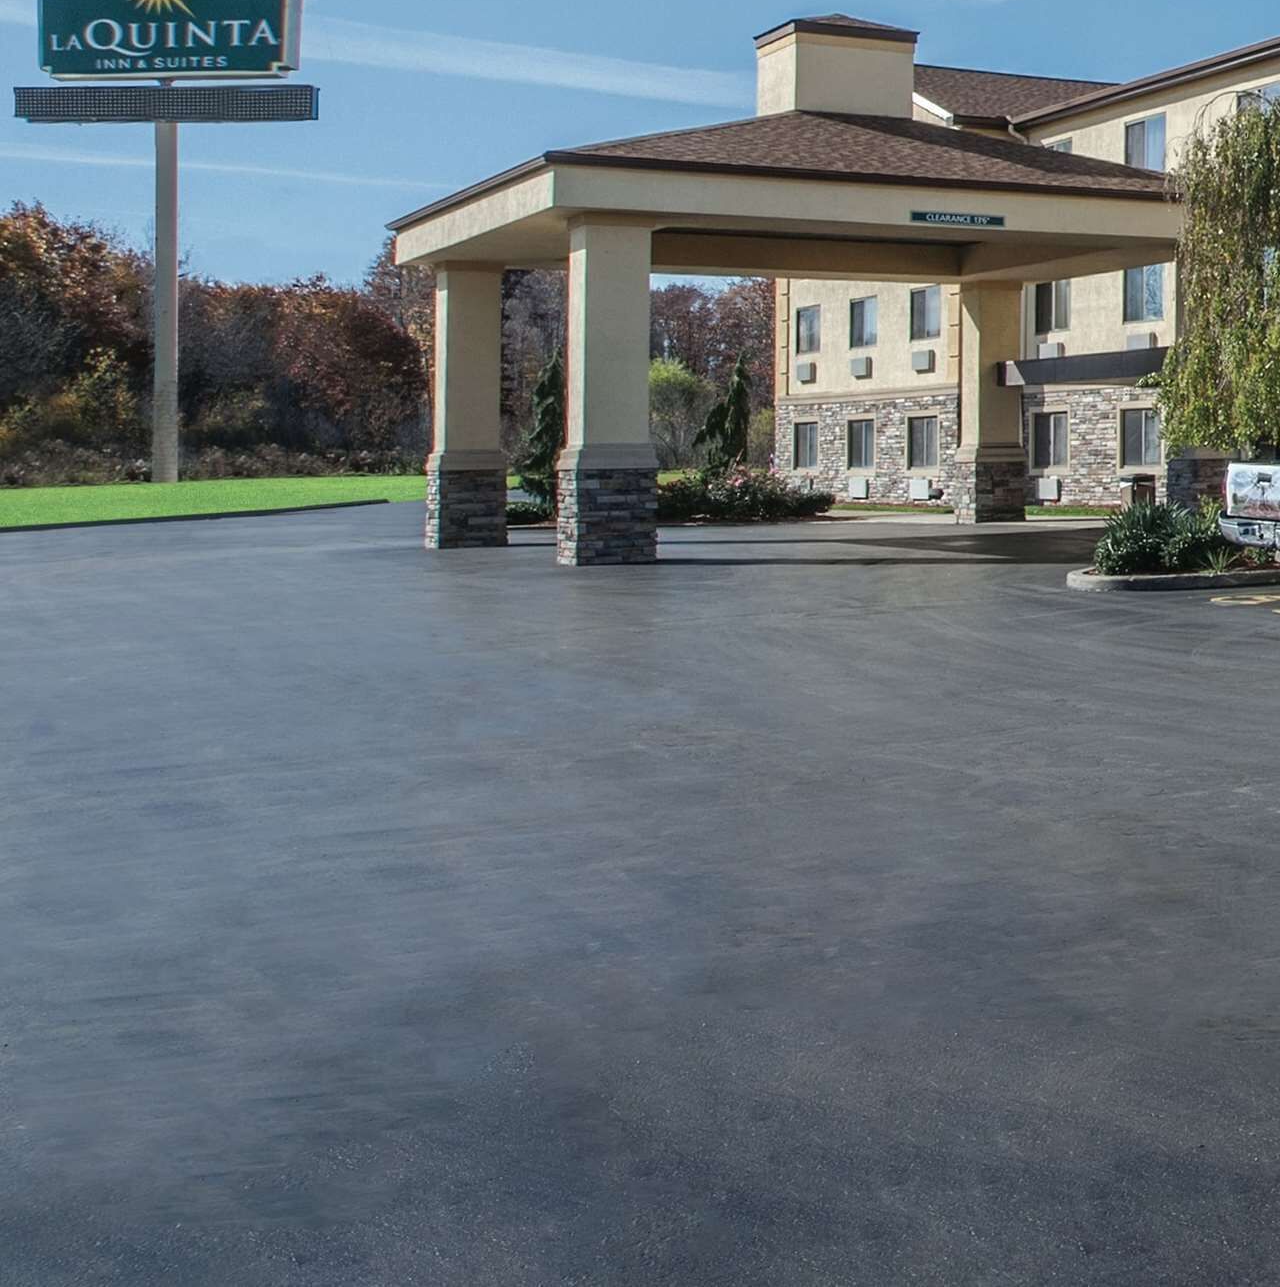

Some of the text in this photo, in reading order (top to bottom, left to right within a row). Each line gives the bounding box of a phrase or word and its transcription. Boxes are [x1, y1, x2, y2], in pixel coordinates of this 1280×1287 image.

[51, 19, 279, 56] LA QUINTA
[96, 56, 228, 69] INN & SUITES
[926, 213, 970, 224] CLEARANCE
